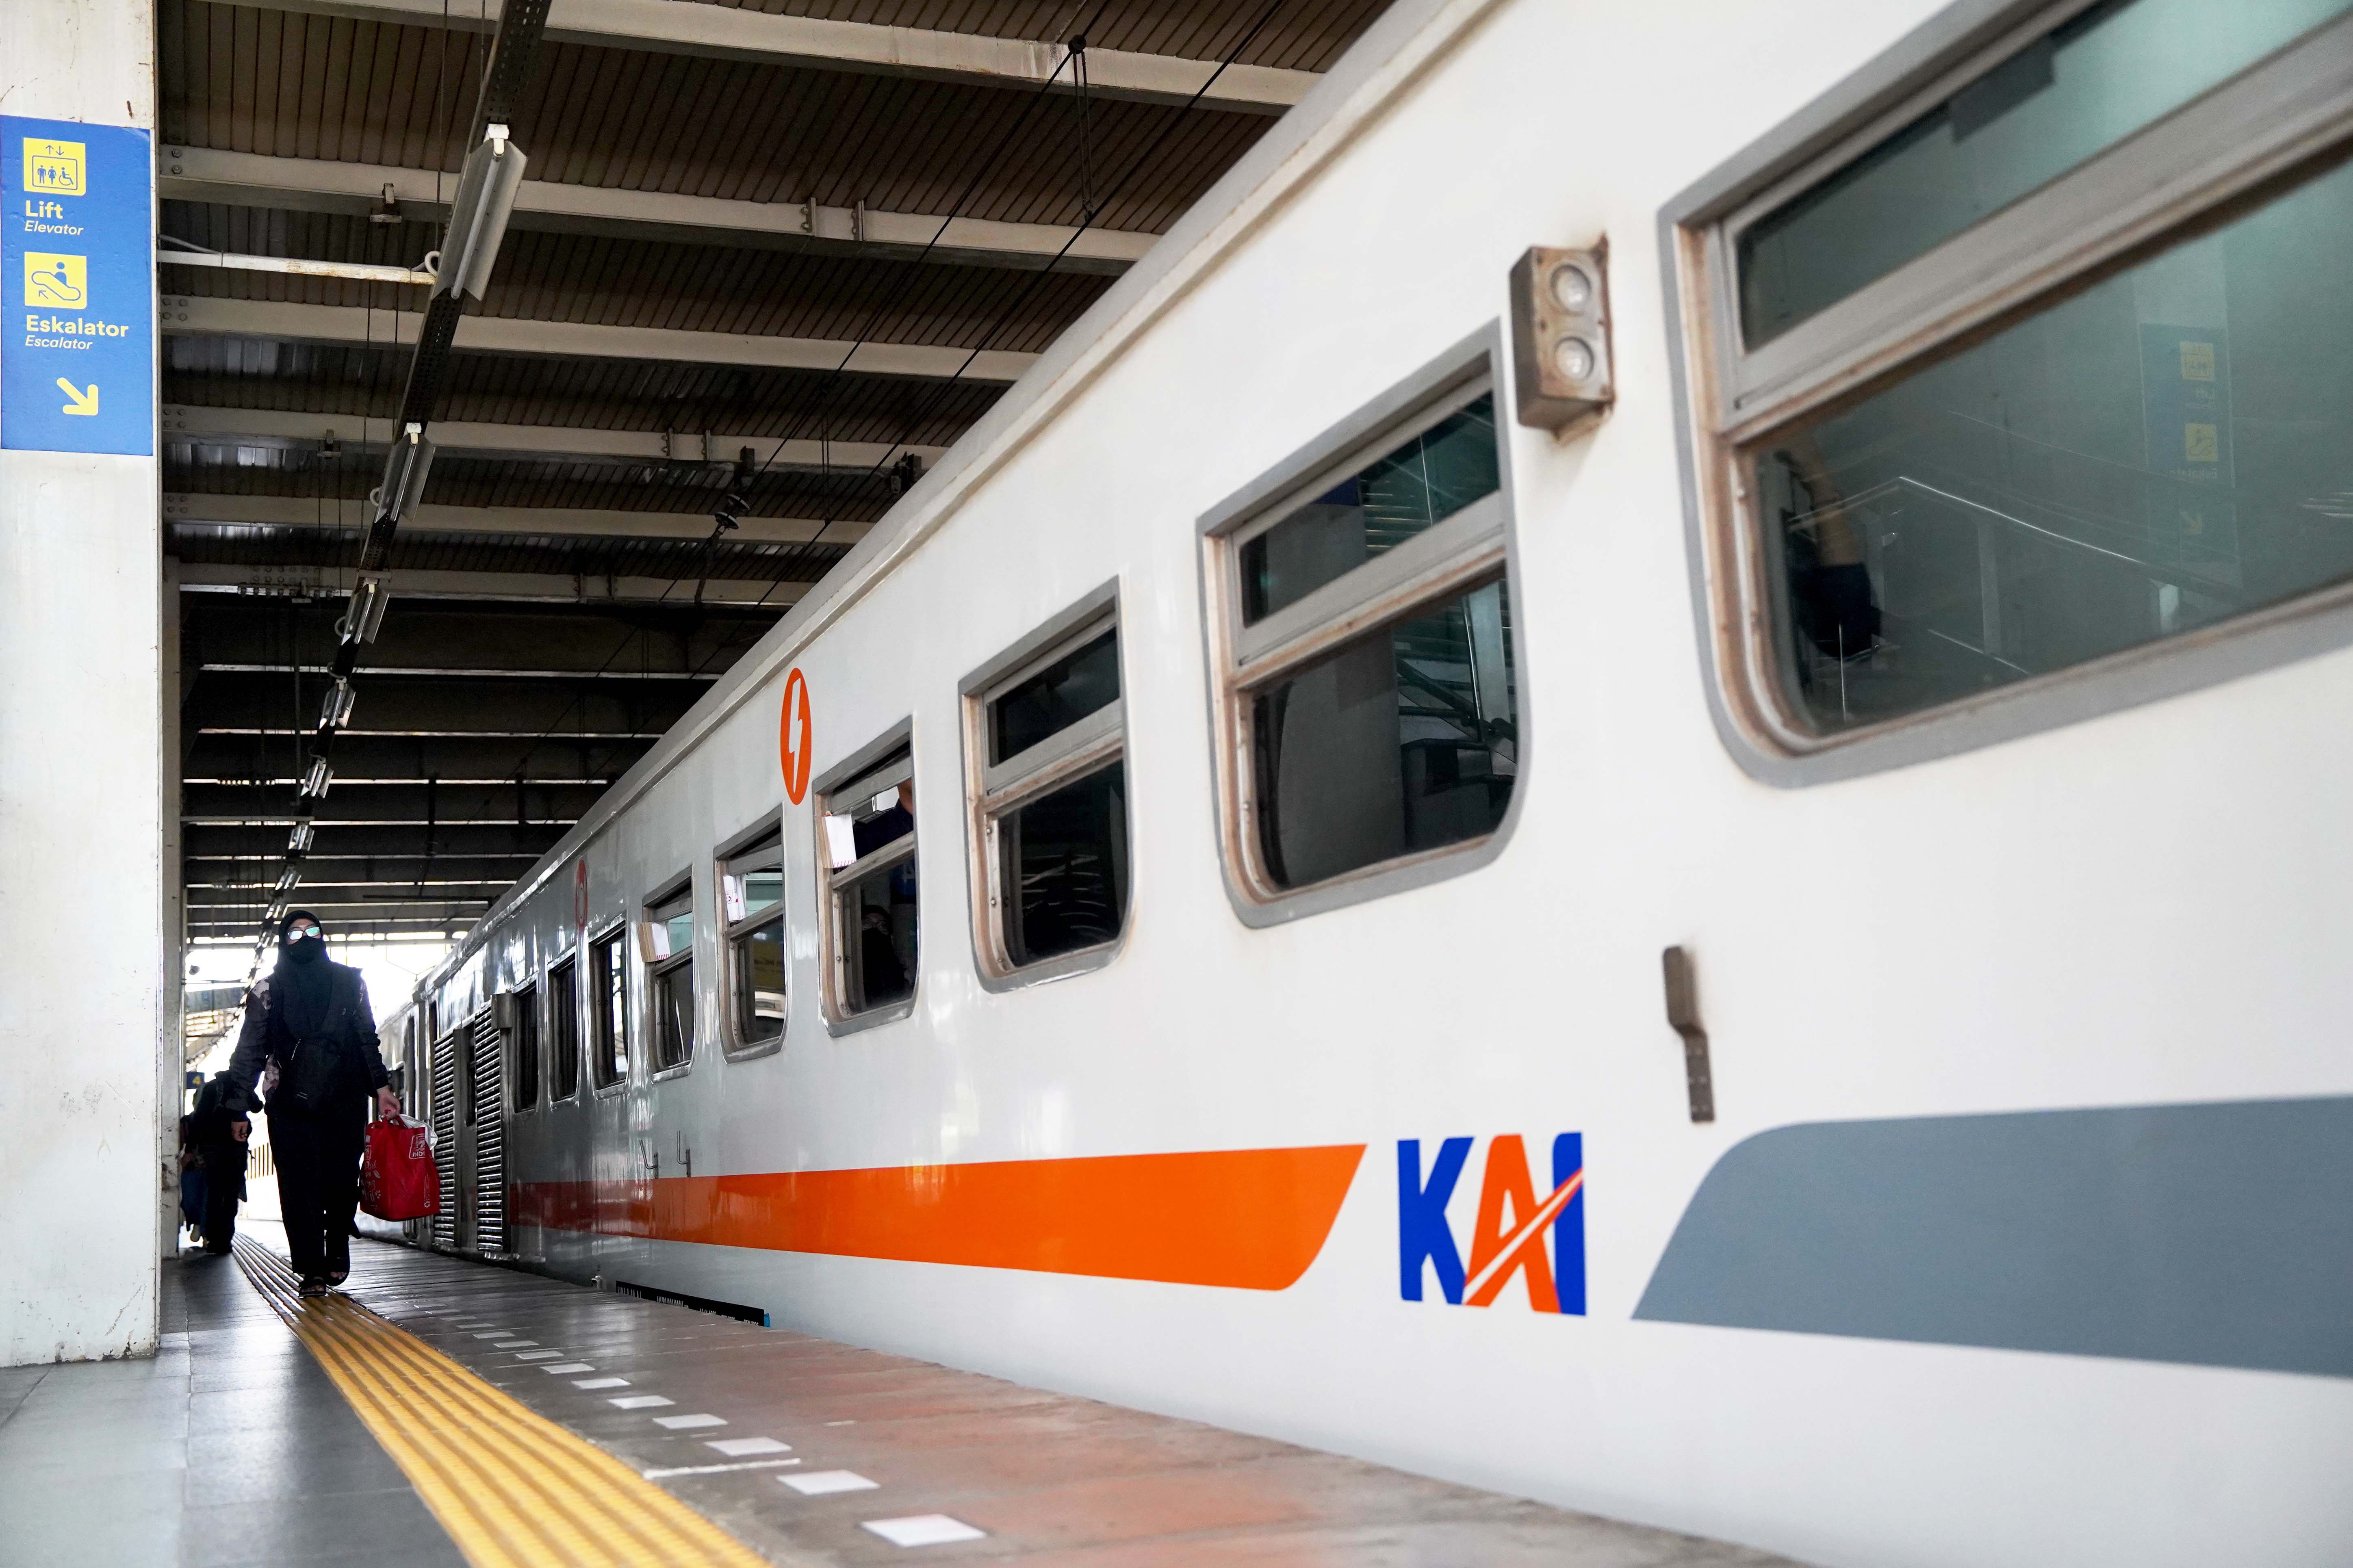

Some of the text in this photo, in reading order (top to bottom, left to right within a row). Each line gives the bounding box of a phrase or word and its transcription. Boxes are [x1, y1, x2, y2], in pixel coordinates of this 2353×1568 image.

[26, 200, 63, 219] Lift
[25, 220, 84, 235] Elevator
[26, 315, 128, 336] Eskalator
[25, 335, 93, 349] Escalator
[1397, 1131, 1586, 1316] KAI
